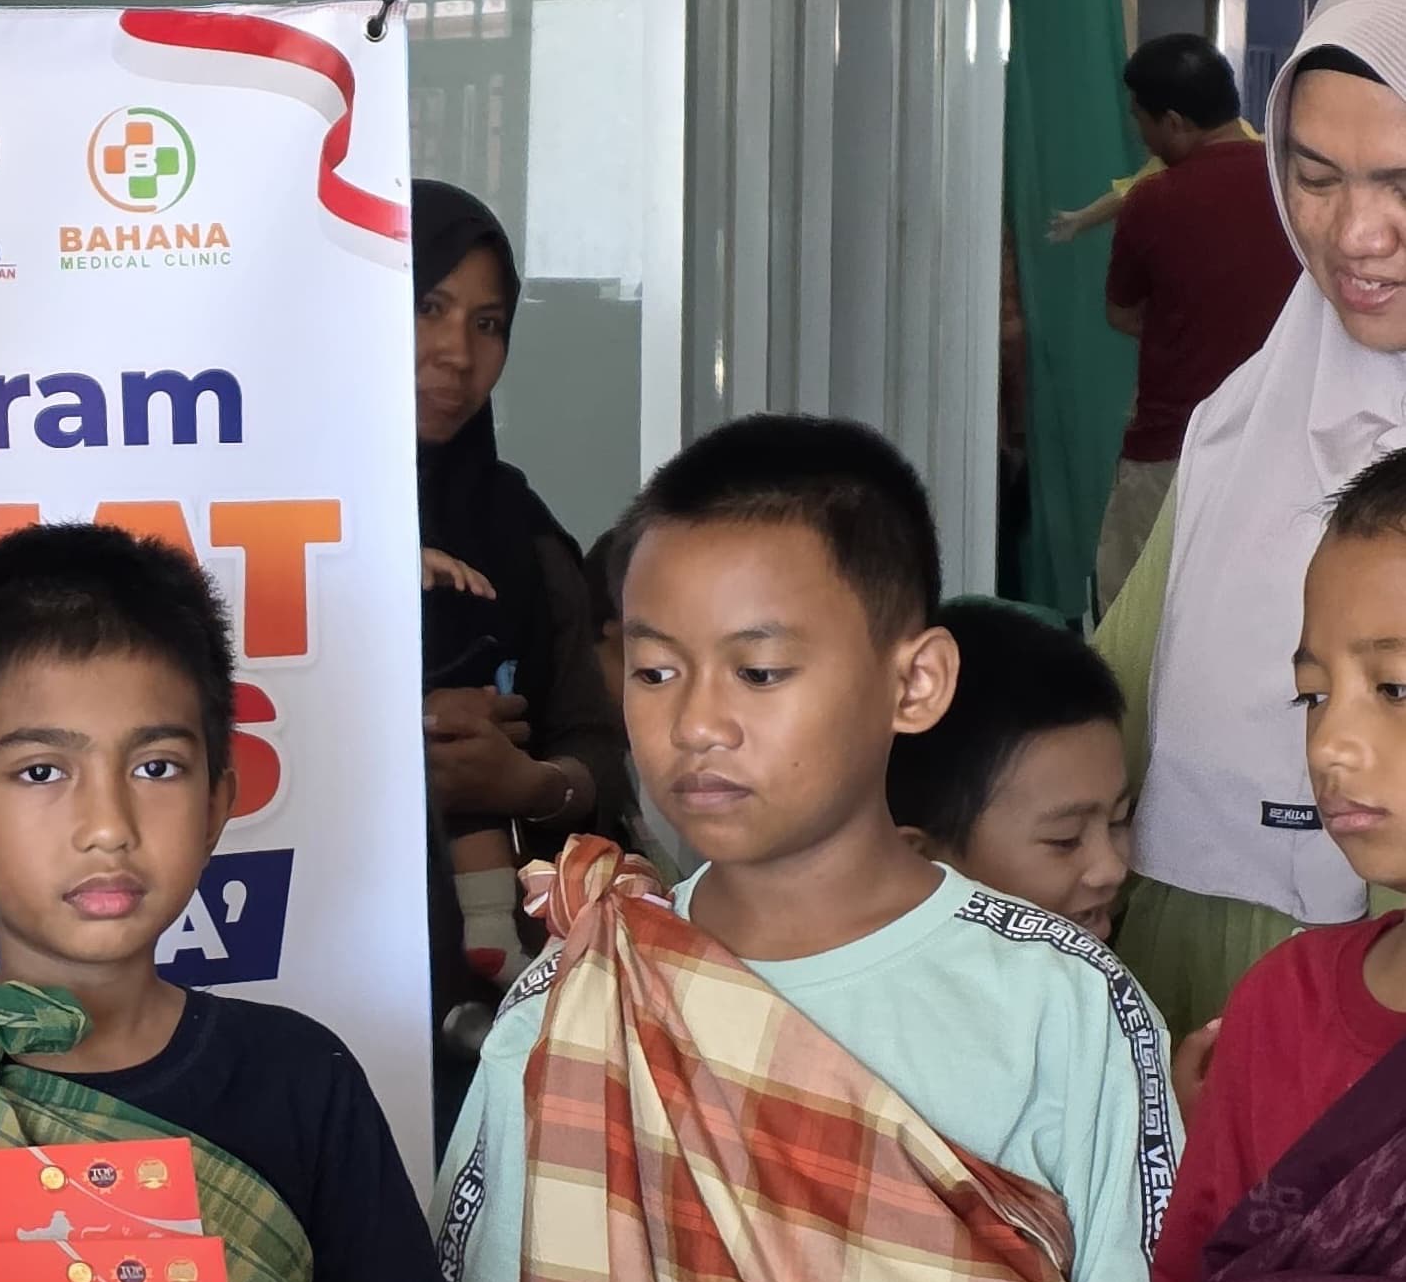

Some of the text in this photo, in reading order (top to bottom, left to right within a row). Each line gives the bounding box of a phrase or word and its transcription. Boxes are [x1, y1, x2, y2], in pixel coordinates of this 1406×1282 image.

[59, 222, 231, 252] BAHANA
[60, 251, 231, 270] MEDICAL CLINIC
[153, 879, 247, 966] A'
